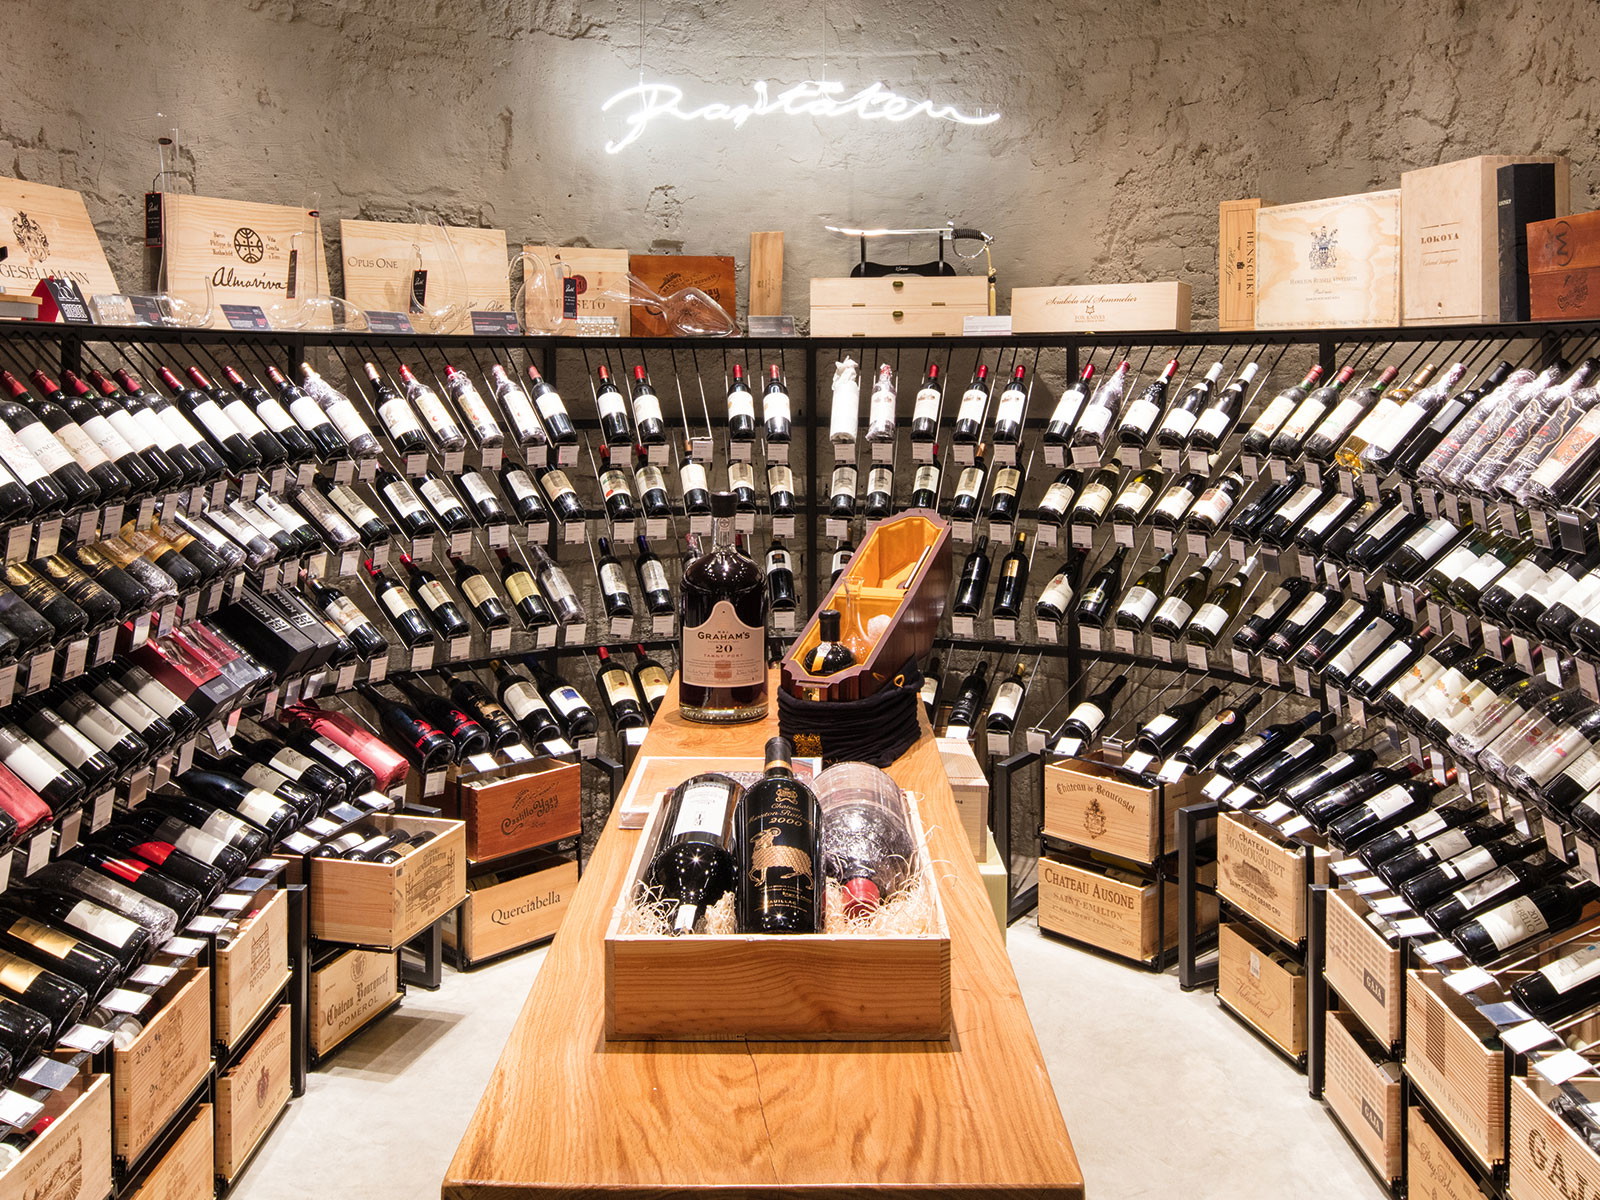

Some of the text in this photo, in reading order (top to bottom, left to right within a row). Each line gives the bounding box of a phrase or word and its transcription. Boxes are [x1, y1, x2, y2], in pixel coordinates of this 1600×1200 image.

[1421, 232, 1460, 245] LOKOYA
[212, 266, 287, 290] Almaviva
[1246, 231, 1254, 298] HENSCHKE
[697, 631, 751, 640] GRAHAM'S
[715, 644, 733, 653] 20
[501, 793, 559, 835] Castillo Ygay
[1095, 783, 1136, 815] Beaucastel
[768, 816, 803, 827] 2000
[1225, 833, 1285, 878] MONBOUSQUET
[1044, 867, 1135, 911] CHATEAU AUSONE
[491, 890, 561, 926] Querciabella
[1518, 909, 1536, 934] BELLO
[1527, 910, 1544, 927] 2011
[1366, 974, 1384, 1001] GAJA
[338, 996, 379, 1030] POMEROL
[1364, 1104, 1383, 1134] GAJA
[1528, 1128, 1600, 1200] GAJ
